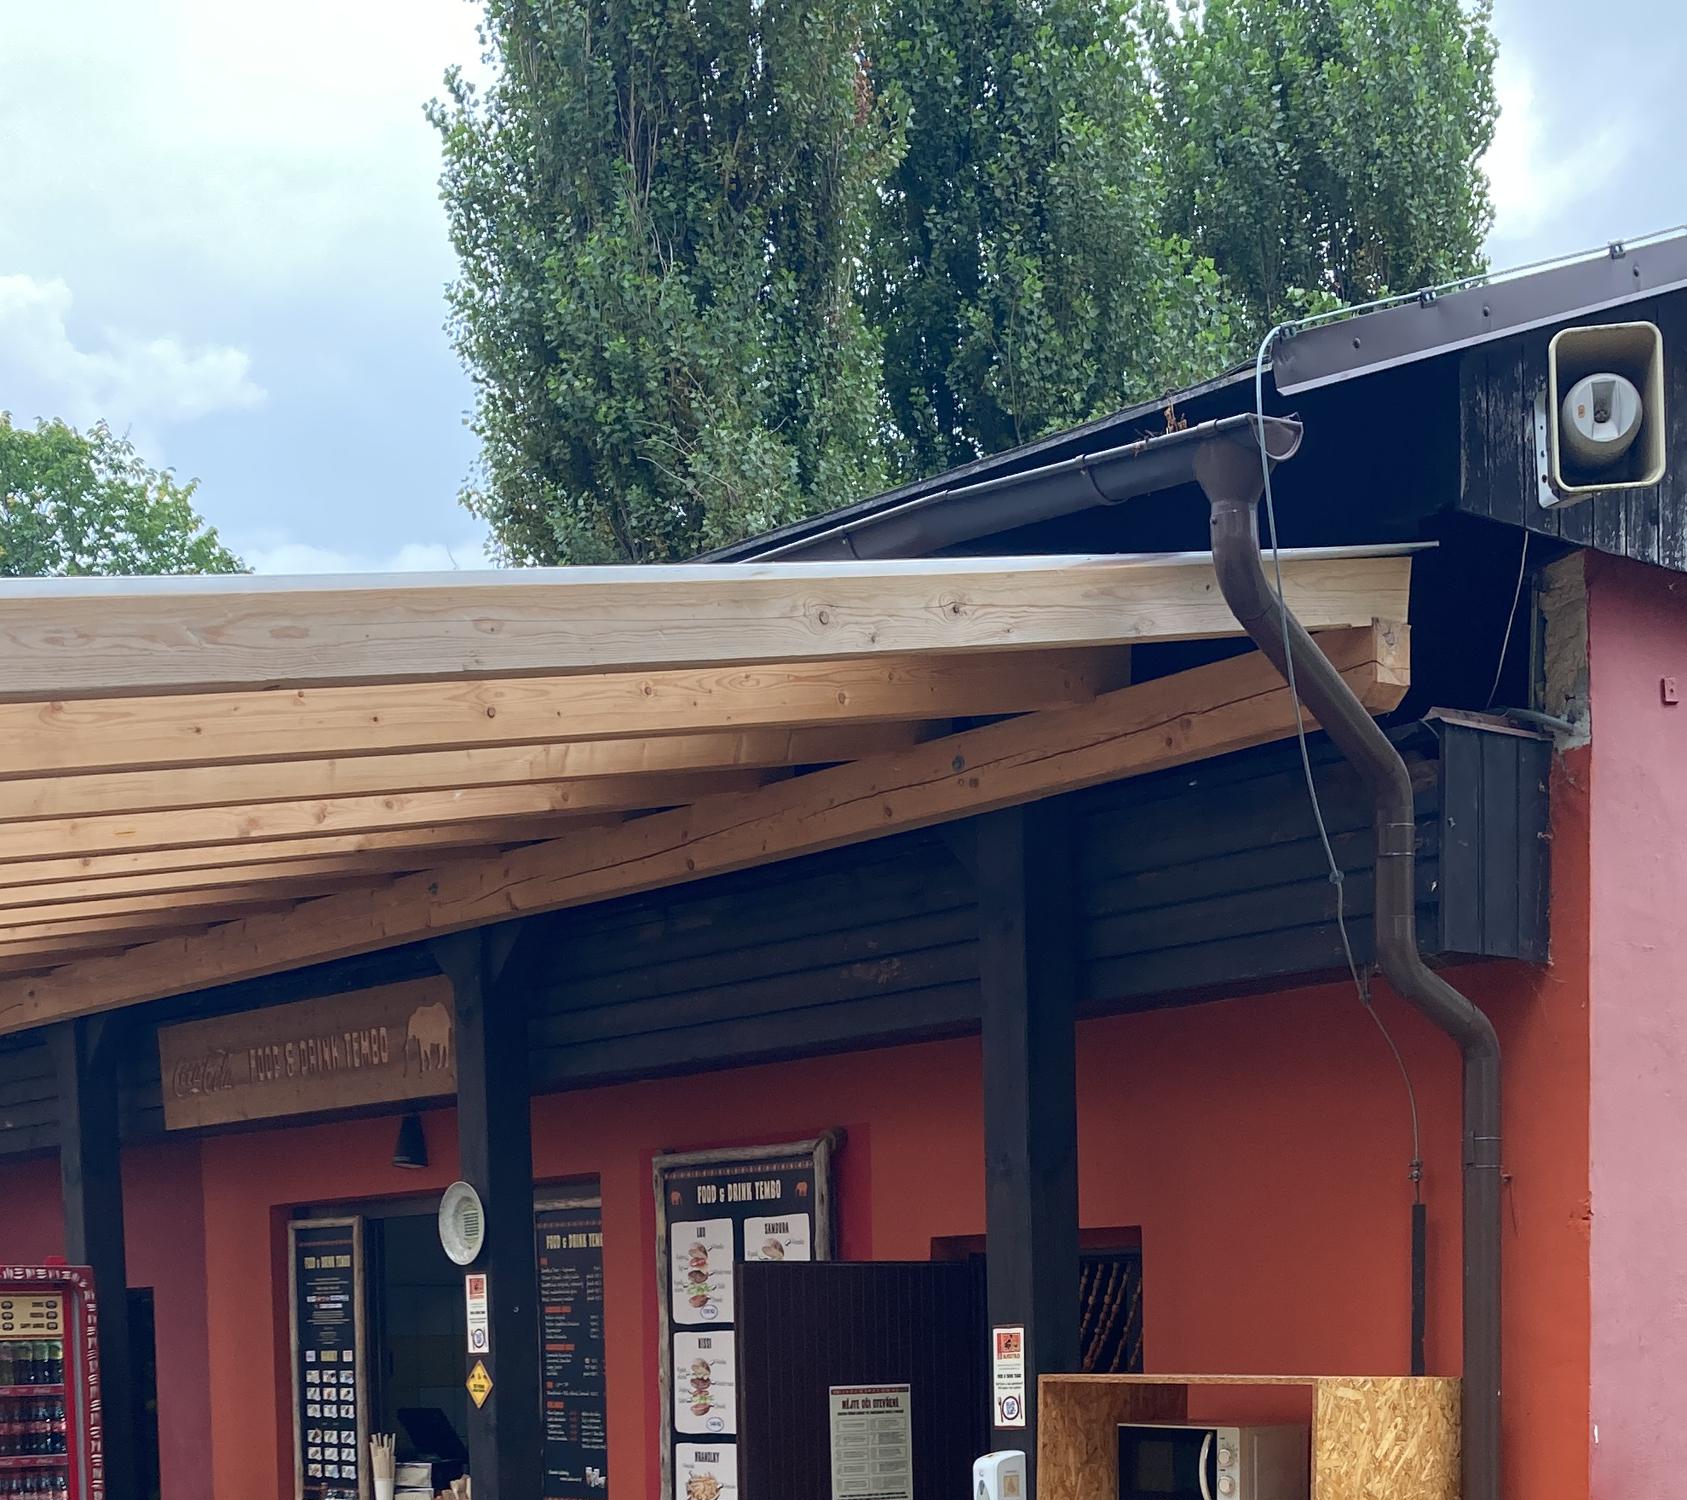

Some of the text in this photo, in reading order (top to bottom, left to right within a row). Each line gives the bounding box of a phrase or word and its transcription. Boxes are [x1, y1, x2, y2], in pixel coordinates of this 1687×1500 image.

[250, 1026, 389, 1082] FOOD & DRINK TEMBO
[697, 1179, 781, 1204] FOOD & DRINK TEMBO
[546, 1234, 561, 1250] FOOD
[568, 1233, 587, 1249] DRINK
